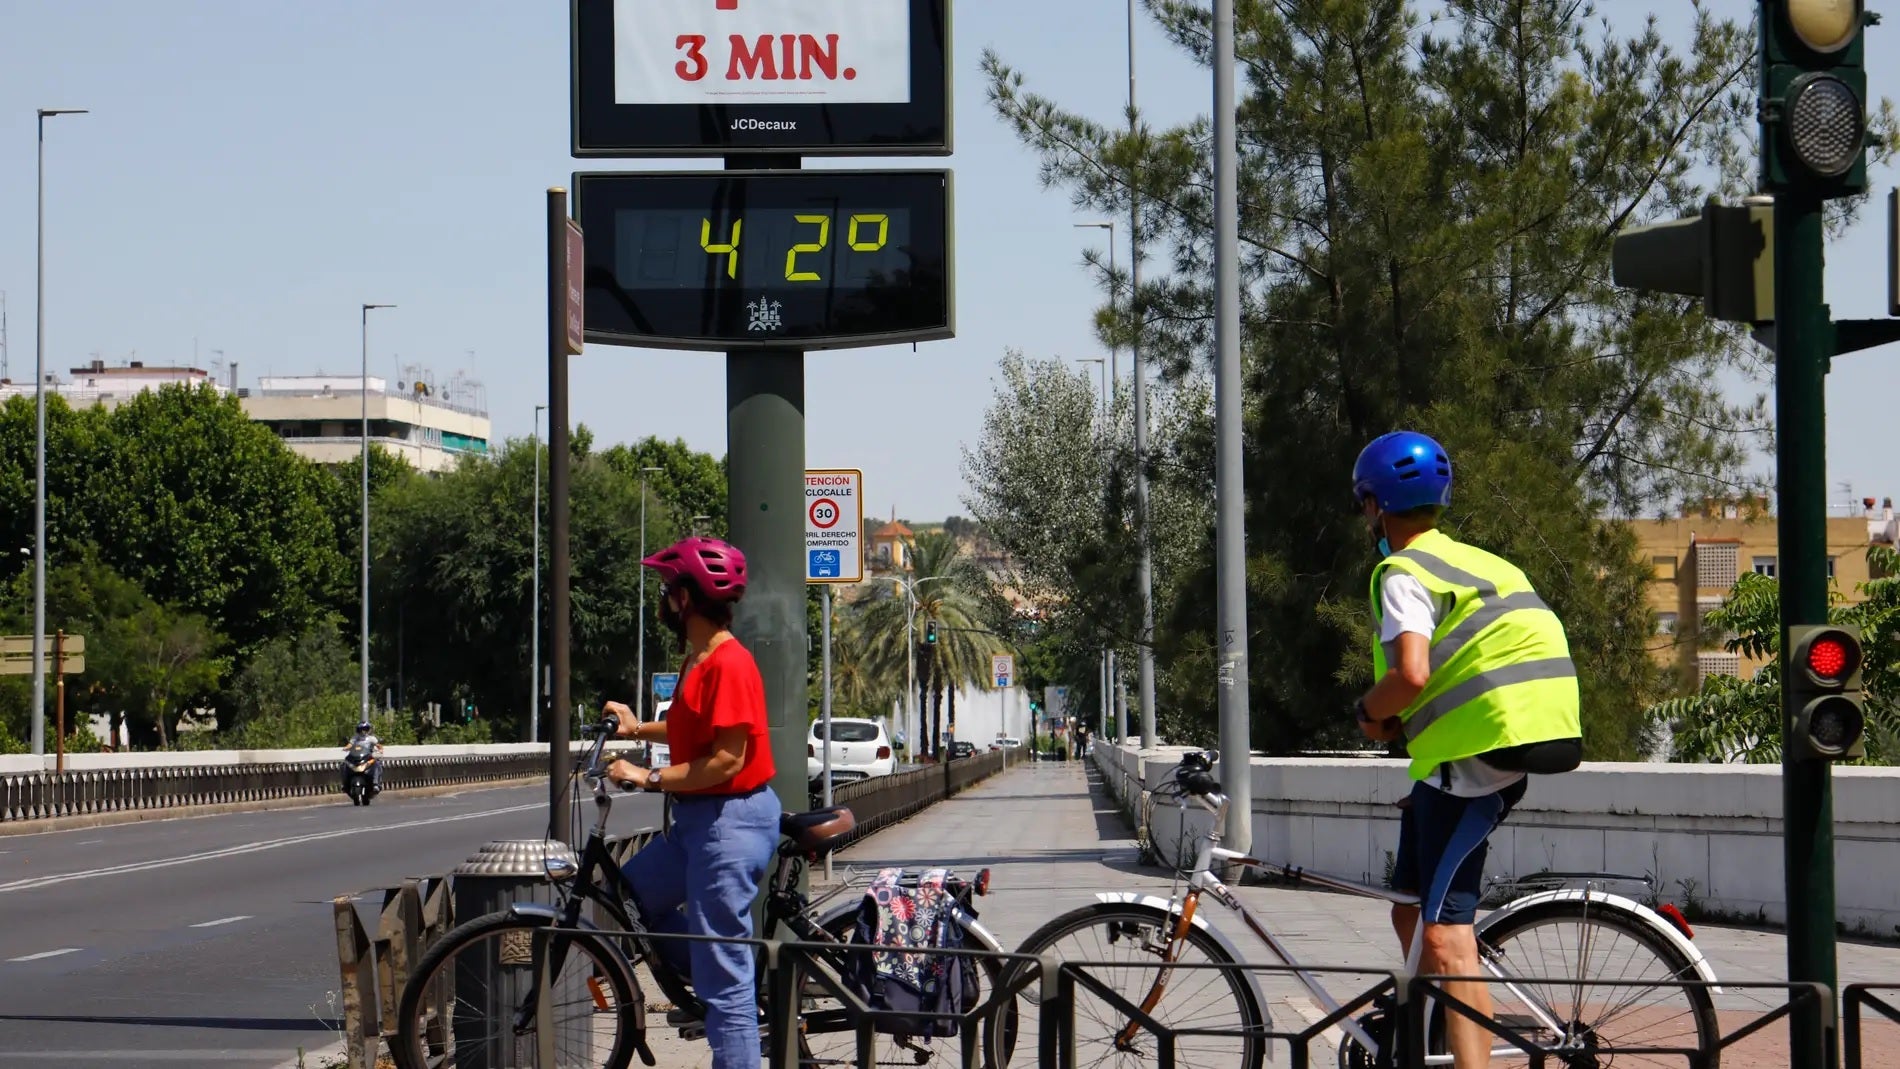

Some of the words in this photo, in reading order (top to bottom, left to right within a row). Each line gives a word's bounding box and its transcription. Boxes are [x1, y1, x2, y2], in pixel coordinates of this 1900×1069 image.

[675, 34, 708, 81] 3
[725, 34, 857, 80] MIN.
[730, 118, 797, 130] JCDecaux
[816, 508, 833, 519] 30
